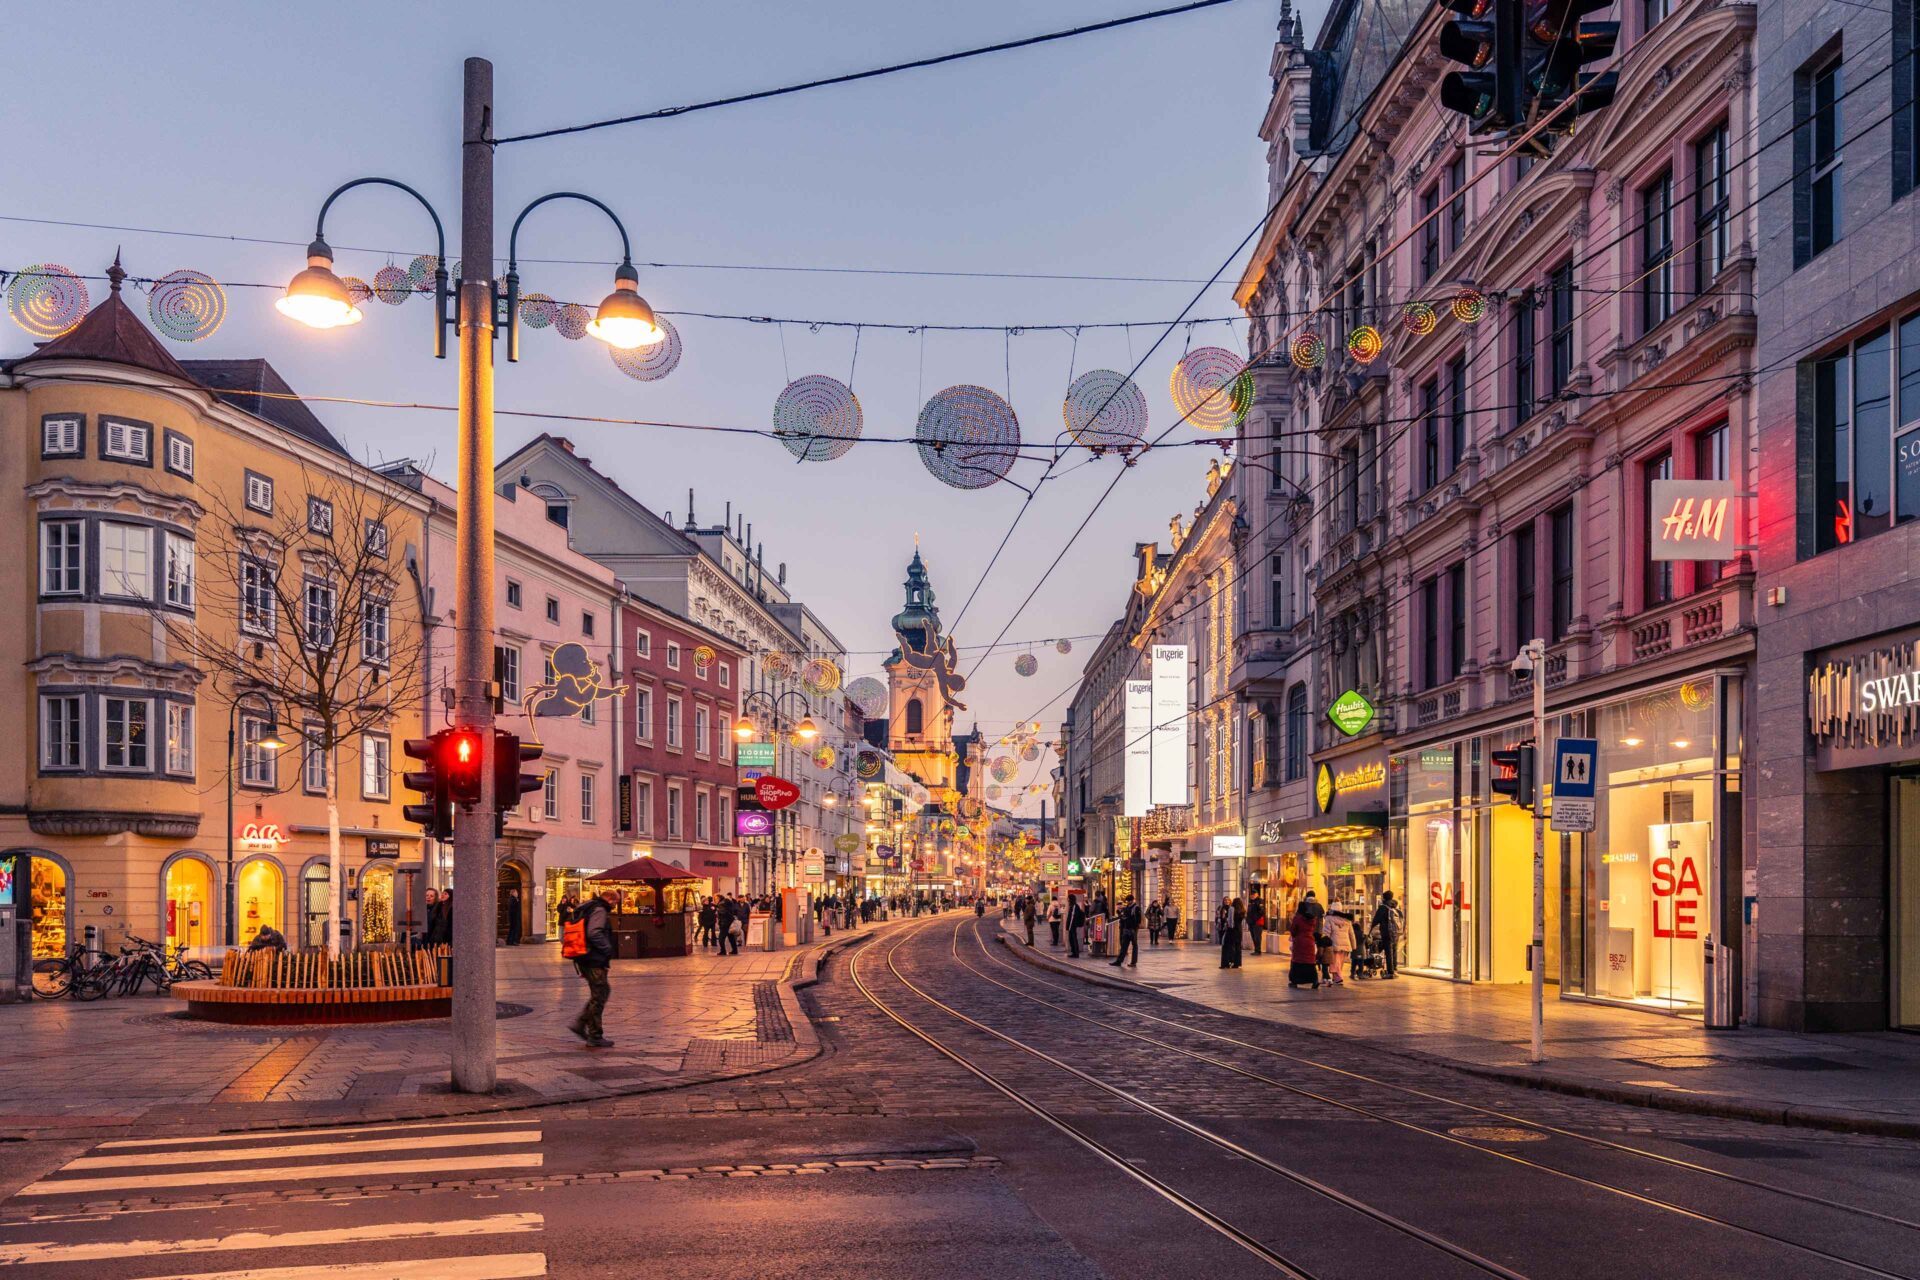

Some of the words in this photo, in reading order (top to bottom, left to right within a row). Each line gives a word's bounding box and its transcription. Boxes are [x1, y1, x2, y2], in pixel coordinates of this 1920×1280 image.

[1661, 498, 1728, 541] H&M
[746, 770, 762, 779] dm
[622, 782, 630, 824] HUMANIC
[1652, 857, 1703, 897] SA
[1653, 900, 1697, 940] LE
